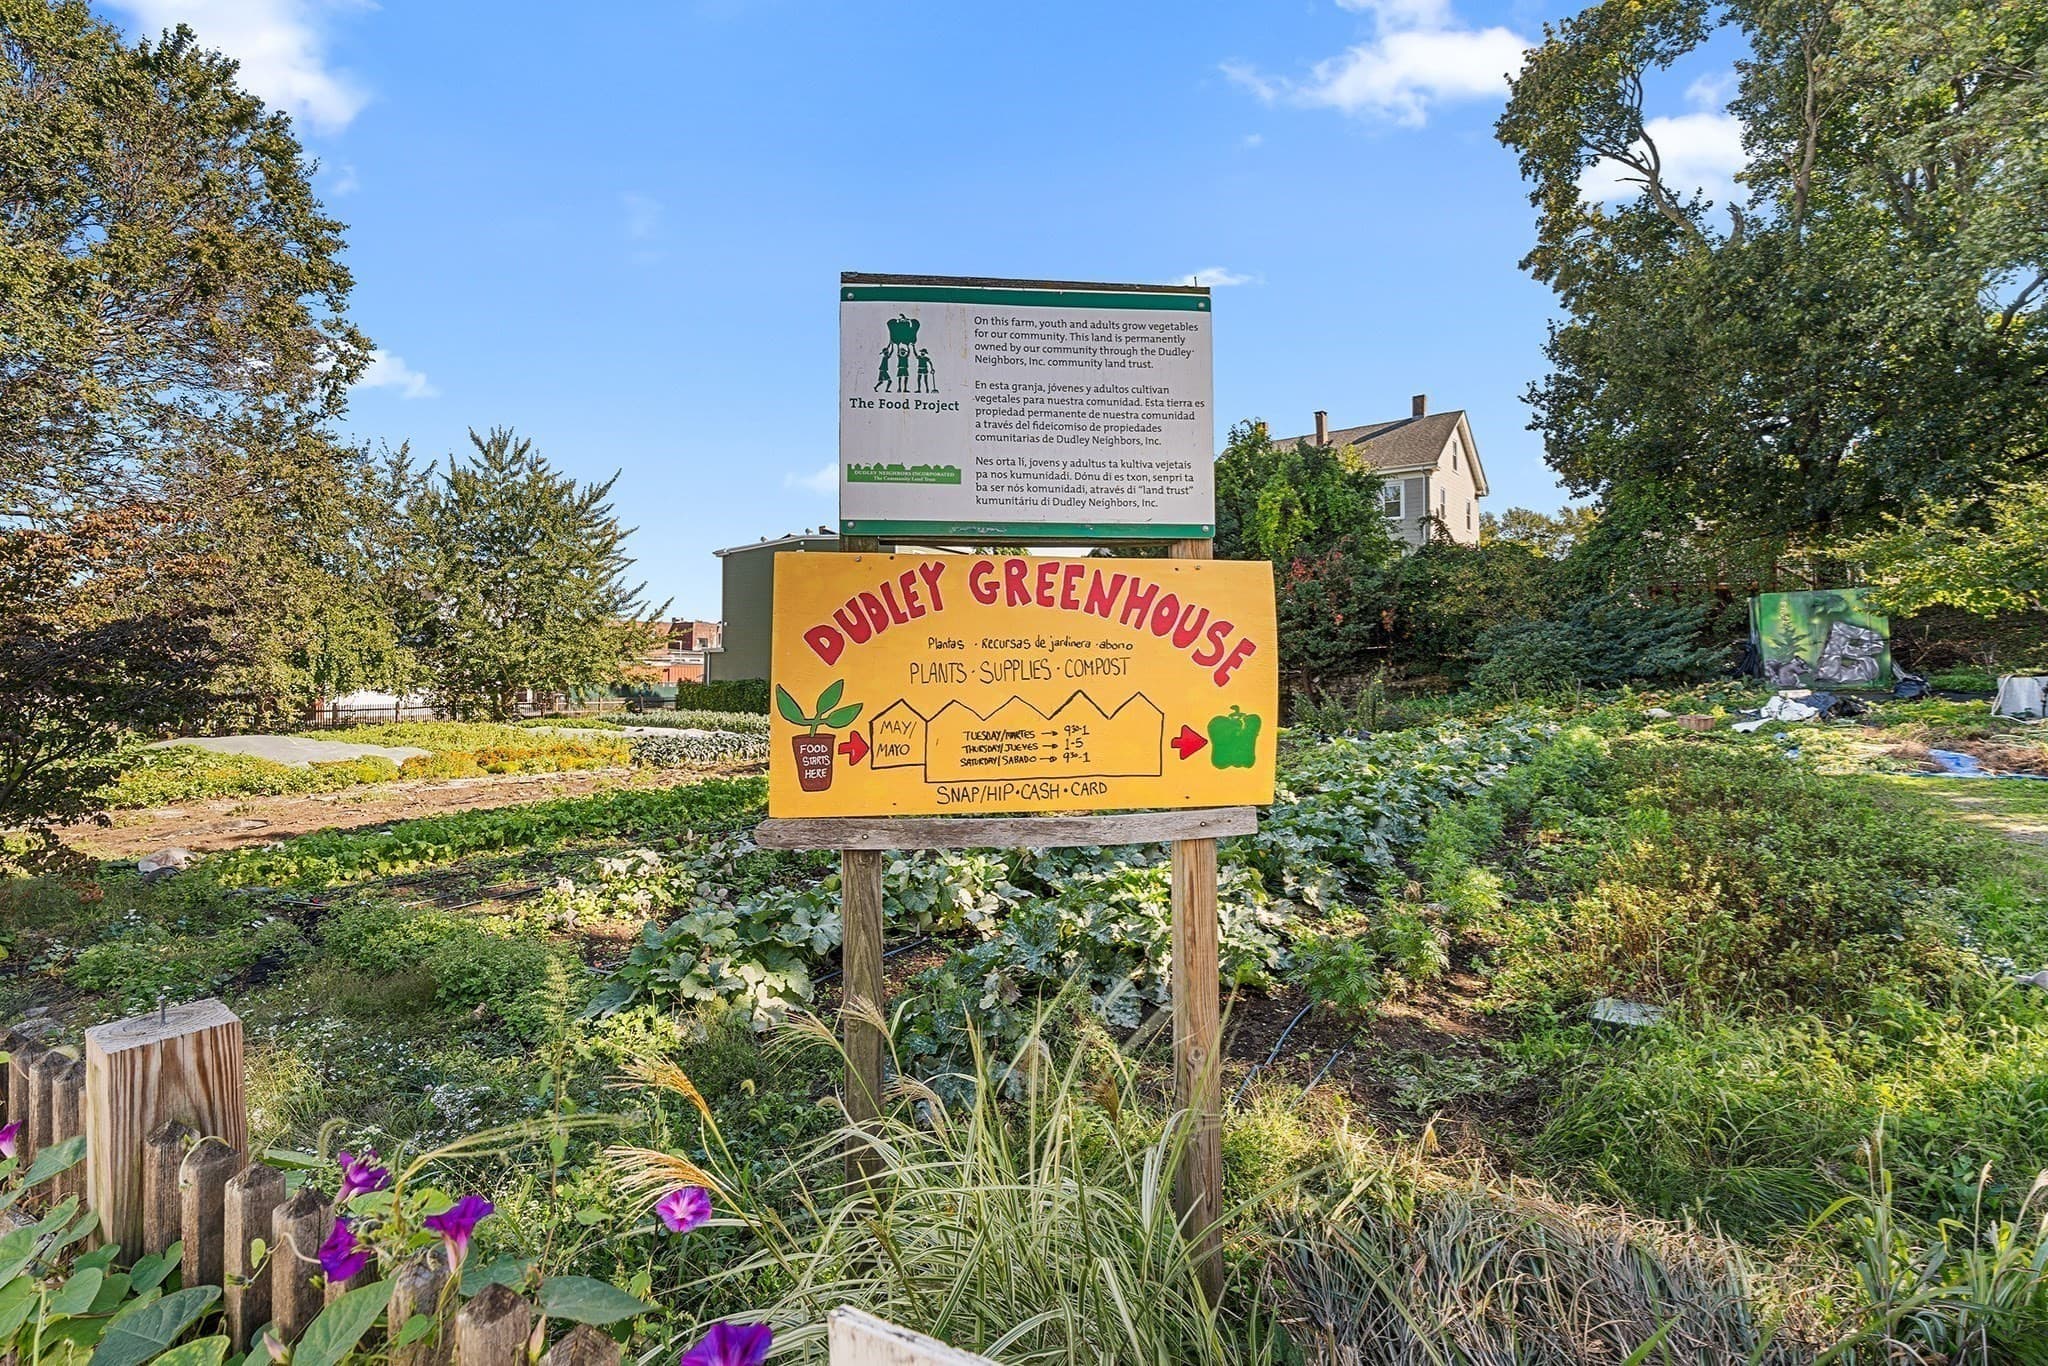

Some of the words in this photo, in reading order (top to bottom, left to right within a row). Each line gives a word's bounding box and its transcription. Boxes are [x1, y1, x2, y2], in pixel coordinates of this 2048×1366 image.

[974, 316, 988, 325] On
[991, 316, 1009, 326] this
[1011, 317, 1037, 328] farm,
[1039, 319, 1067, 330] youth
[1069, 320, 1088, 328] and
[1090, 320, 1120, 329] adults
[1122, 323, 1146, 332] grow
[1148, 322, 1198, 333] vegetables
[975, 329, 989, 337] for
[1010, 332, 1067, 343] community.
[1069, 332, 1089, 341] This
[1091, 333, 1112, 342] land
[1115, 334, 1122, 342] is
[1125, 335, 1185, 346] permanently
[975, 343, 1007, 351] owned
[1010, 343, 1021, 354] by
[1042, 346, 1097, 357] community
[1100, 346, 1138, 358] through
[1140, 347, 1156, 355] the
[975, 355, 1027, 366] Neighbors,
[1029, 357, 1045, 366] Inc.
[1048, 359, 1102, 370] community
[1105, 359, 1126, 368] land
[1128, 360, 1153, 368] trust.
[975, 380, 987, 389] En
[989, 382, 1009, 390] esta
[1012, 383, 1045, 393] granja,
[1047, 383, 1084, 394] jóvenes
[1086, 386, 1091, 395] y
[1094, 384, 1129, 393] adultos
[1131, 385, 1169, 394] cultivan
[849, 398, 874, 409] The
[879, 399, 910, 409] Food
[914, 400, 959, 413] Project
[975, 394, 1020, 405] vegetales
[1023, 397, 1045, 405] para
[1086, 398, 1143, 406] comunidad.
[1145, 398, 1164, 407] Esta
[1167, 399, 1193, 407] tierra
[975, 407, 1025, 417] propiedad
[1028, 410, 1086, 419] permanente
[1089, 410, 1100, 418] de
[1103, 411, 1139, 419] nuestra
[1141, 411, 1195, 420] comunidad
[984, 420, 1013, 429] través
[1015, 421, 1030, 429] del
[1032, 421, 1087, 431] fideicomiso
[1089, 422, 1101, 431] de
[1103, 423, 1162, 434] propiedades
[975, 434, 1042, 443] comunitarias
[1041, 434, 1054, 443] de
[1057, 435, 1090, 446] Dudley
[1092, 436, 1143, 447] Neighbors,
[1145, 437, 1161, 445] Inc.
[976, 457, 993, 465] Nes
[996, 457, 1016, 466] orta
[1029, 458, 1060, 469] jovens
[1062, 461, 1067, 470] y
[1070, 458, 1106, 468] adultus
[1120, 459, 1153, 468] kultiva
[976, 472, 988, 480] pa
[1103, 472, 1111, 481] di
[1185, 474, 1194, 482] ta
[976, 482, 988, 491] ba
[1090, 485, 1124, 494] através
[1127, 485, 1136, 494] di
[1041, 497, 1050, 505] di
[1052, 497, 1086, 509] Dudley
[1089, 498, 1139, 509] Neighbors,
[1142, 499, 1158, 507] Inc.
[803, 560, 946, 666] DUDLEY
[968, 559, 1257, 687] GREENHOUSE
[928, 637, 964, 649] Plantas
[1035, 635, 1046, 648] de
[1049, 636, 1091, 652] jardinera
[909, 662, 967, 684] PLANTS
[980, 658, 1052, 684] SUPPLIES
[1064, 657, 1131, 679] COMPOST
[880, 720, 917, 739] MAY/
[800, 744, 828, 754] FOOD
[876, 743, 910, 758] MAYO
[1065, 738, 1084, 750] 1-5
[802, 755, 830, 766] STARTS
[805, 768, 827, 779] HERE
